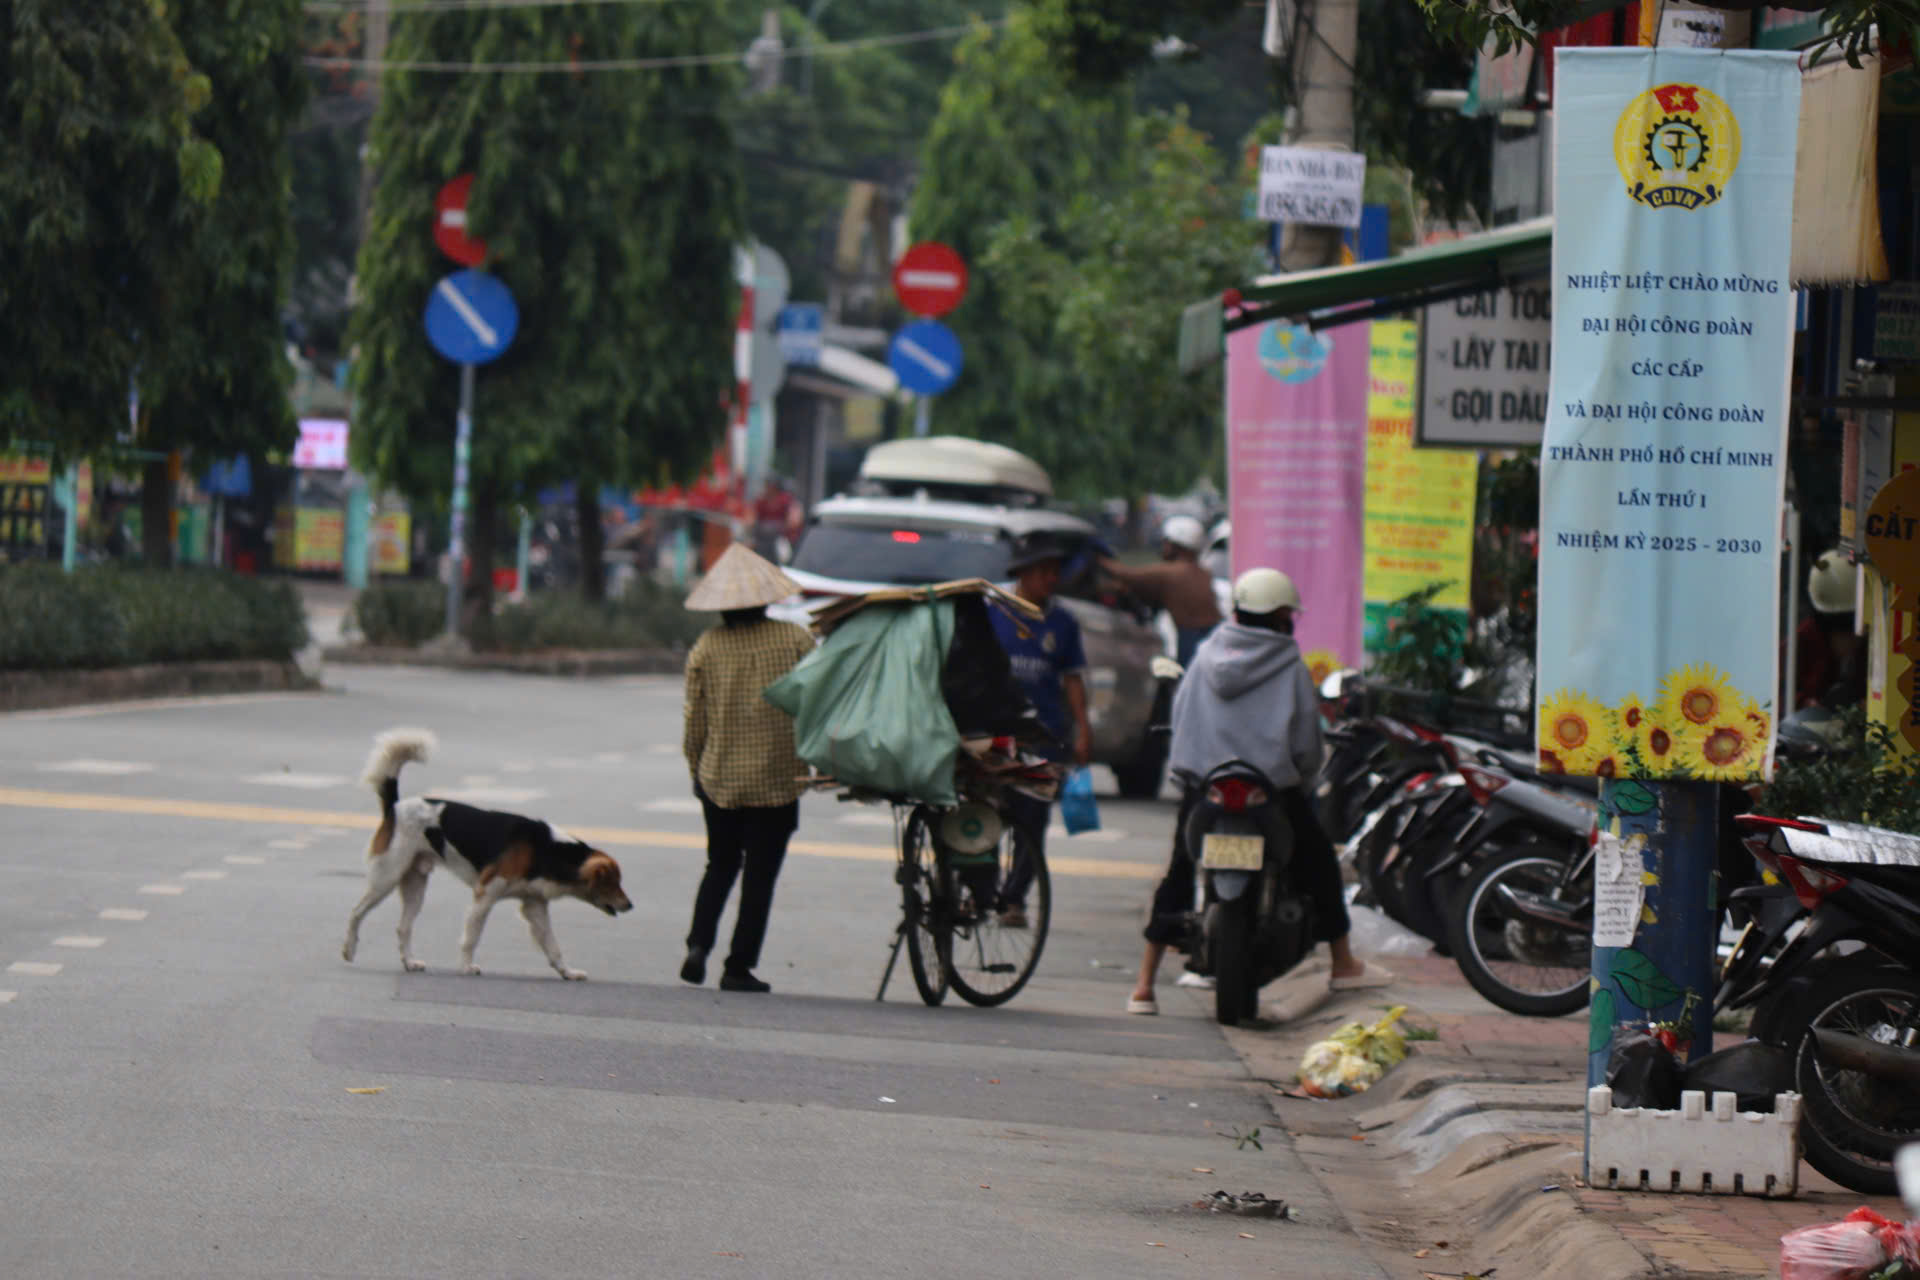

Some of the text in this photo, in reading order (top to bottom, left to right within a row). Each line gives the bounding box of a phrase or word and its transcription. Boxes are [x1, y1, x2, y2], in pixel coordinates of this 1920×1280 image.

[1567, 271, 1779, 295] NHIỆT LIỆT CHÀO MỪNG
[1582, 314, 1753, 337] ĐẠI HỘI CÔNG ĐOÀN
[1503, 339, 1539, 371] TAI
[1631, 358, 1704, 378] CÁC CẤP
[1565, 400, 1765, 424] VÀ ĐẠI HỘI CÔNG ĐOÀN
[1549, 443, 1614, 462] THÀNH
[1620, 443, 1654, 463] PHỐ
[1690, 447, 1724, 466] CHÍ
[1727, 451, 1774, 467] MINH
[1656, 490, 1697, 509] THỨ
[1701, 494, 1707, 509] I
[1557, 530, 1619, 553] NHIỆM
[1625, 531, 1647, 551] KỲ
[1651, 535, 1697, 552] 2025
[1716, 538, 1762, 554] 2030
